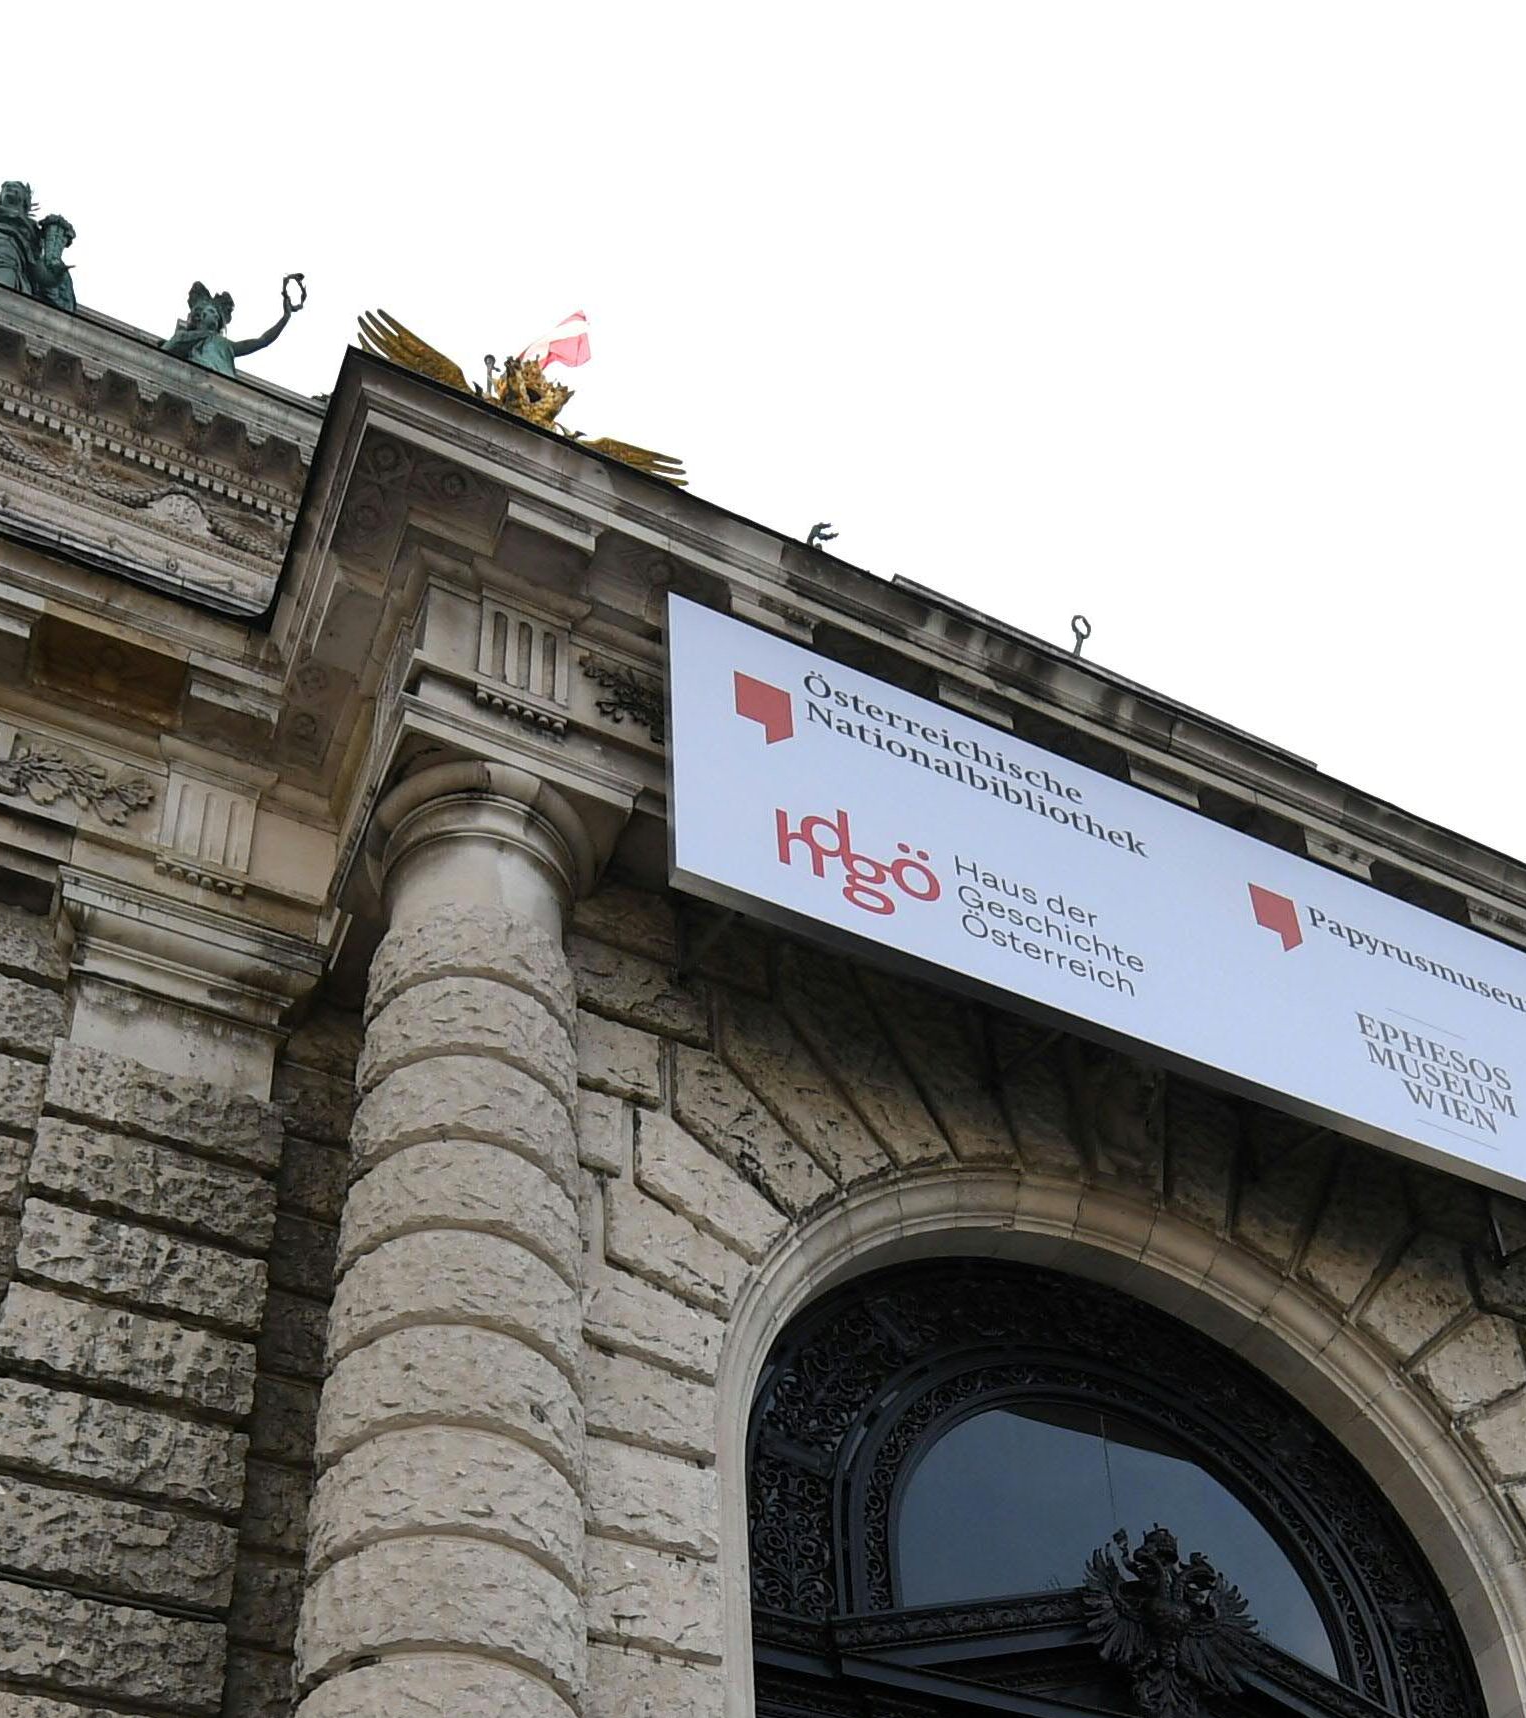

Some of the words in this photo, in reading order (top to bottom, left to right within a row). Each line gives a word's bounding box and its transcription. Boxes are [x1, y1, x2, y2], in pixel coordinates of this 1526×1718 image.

[803, 670, 1083, 805] Österreichische
[806, 700, 1150, 858] Nationalbibliothek
[954, 854, 1038, 906] Haus
[1046, 894, 1098, 928] der
[957, 885, 1145, 973] Geschichte
[962, 909, 1136, 997] Österreich
[1355, 1011, 1512, 1091] EPHESOS
[1365, 1039, 1520, 1118] MUSEUM
[1401, 1079, 1499, 1136] WIEN
